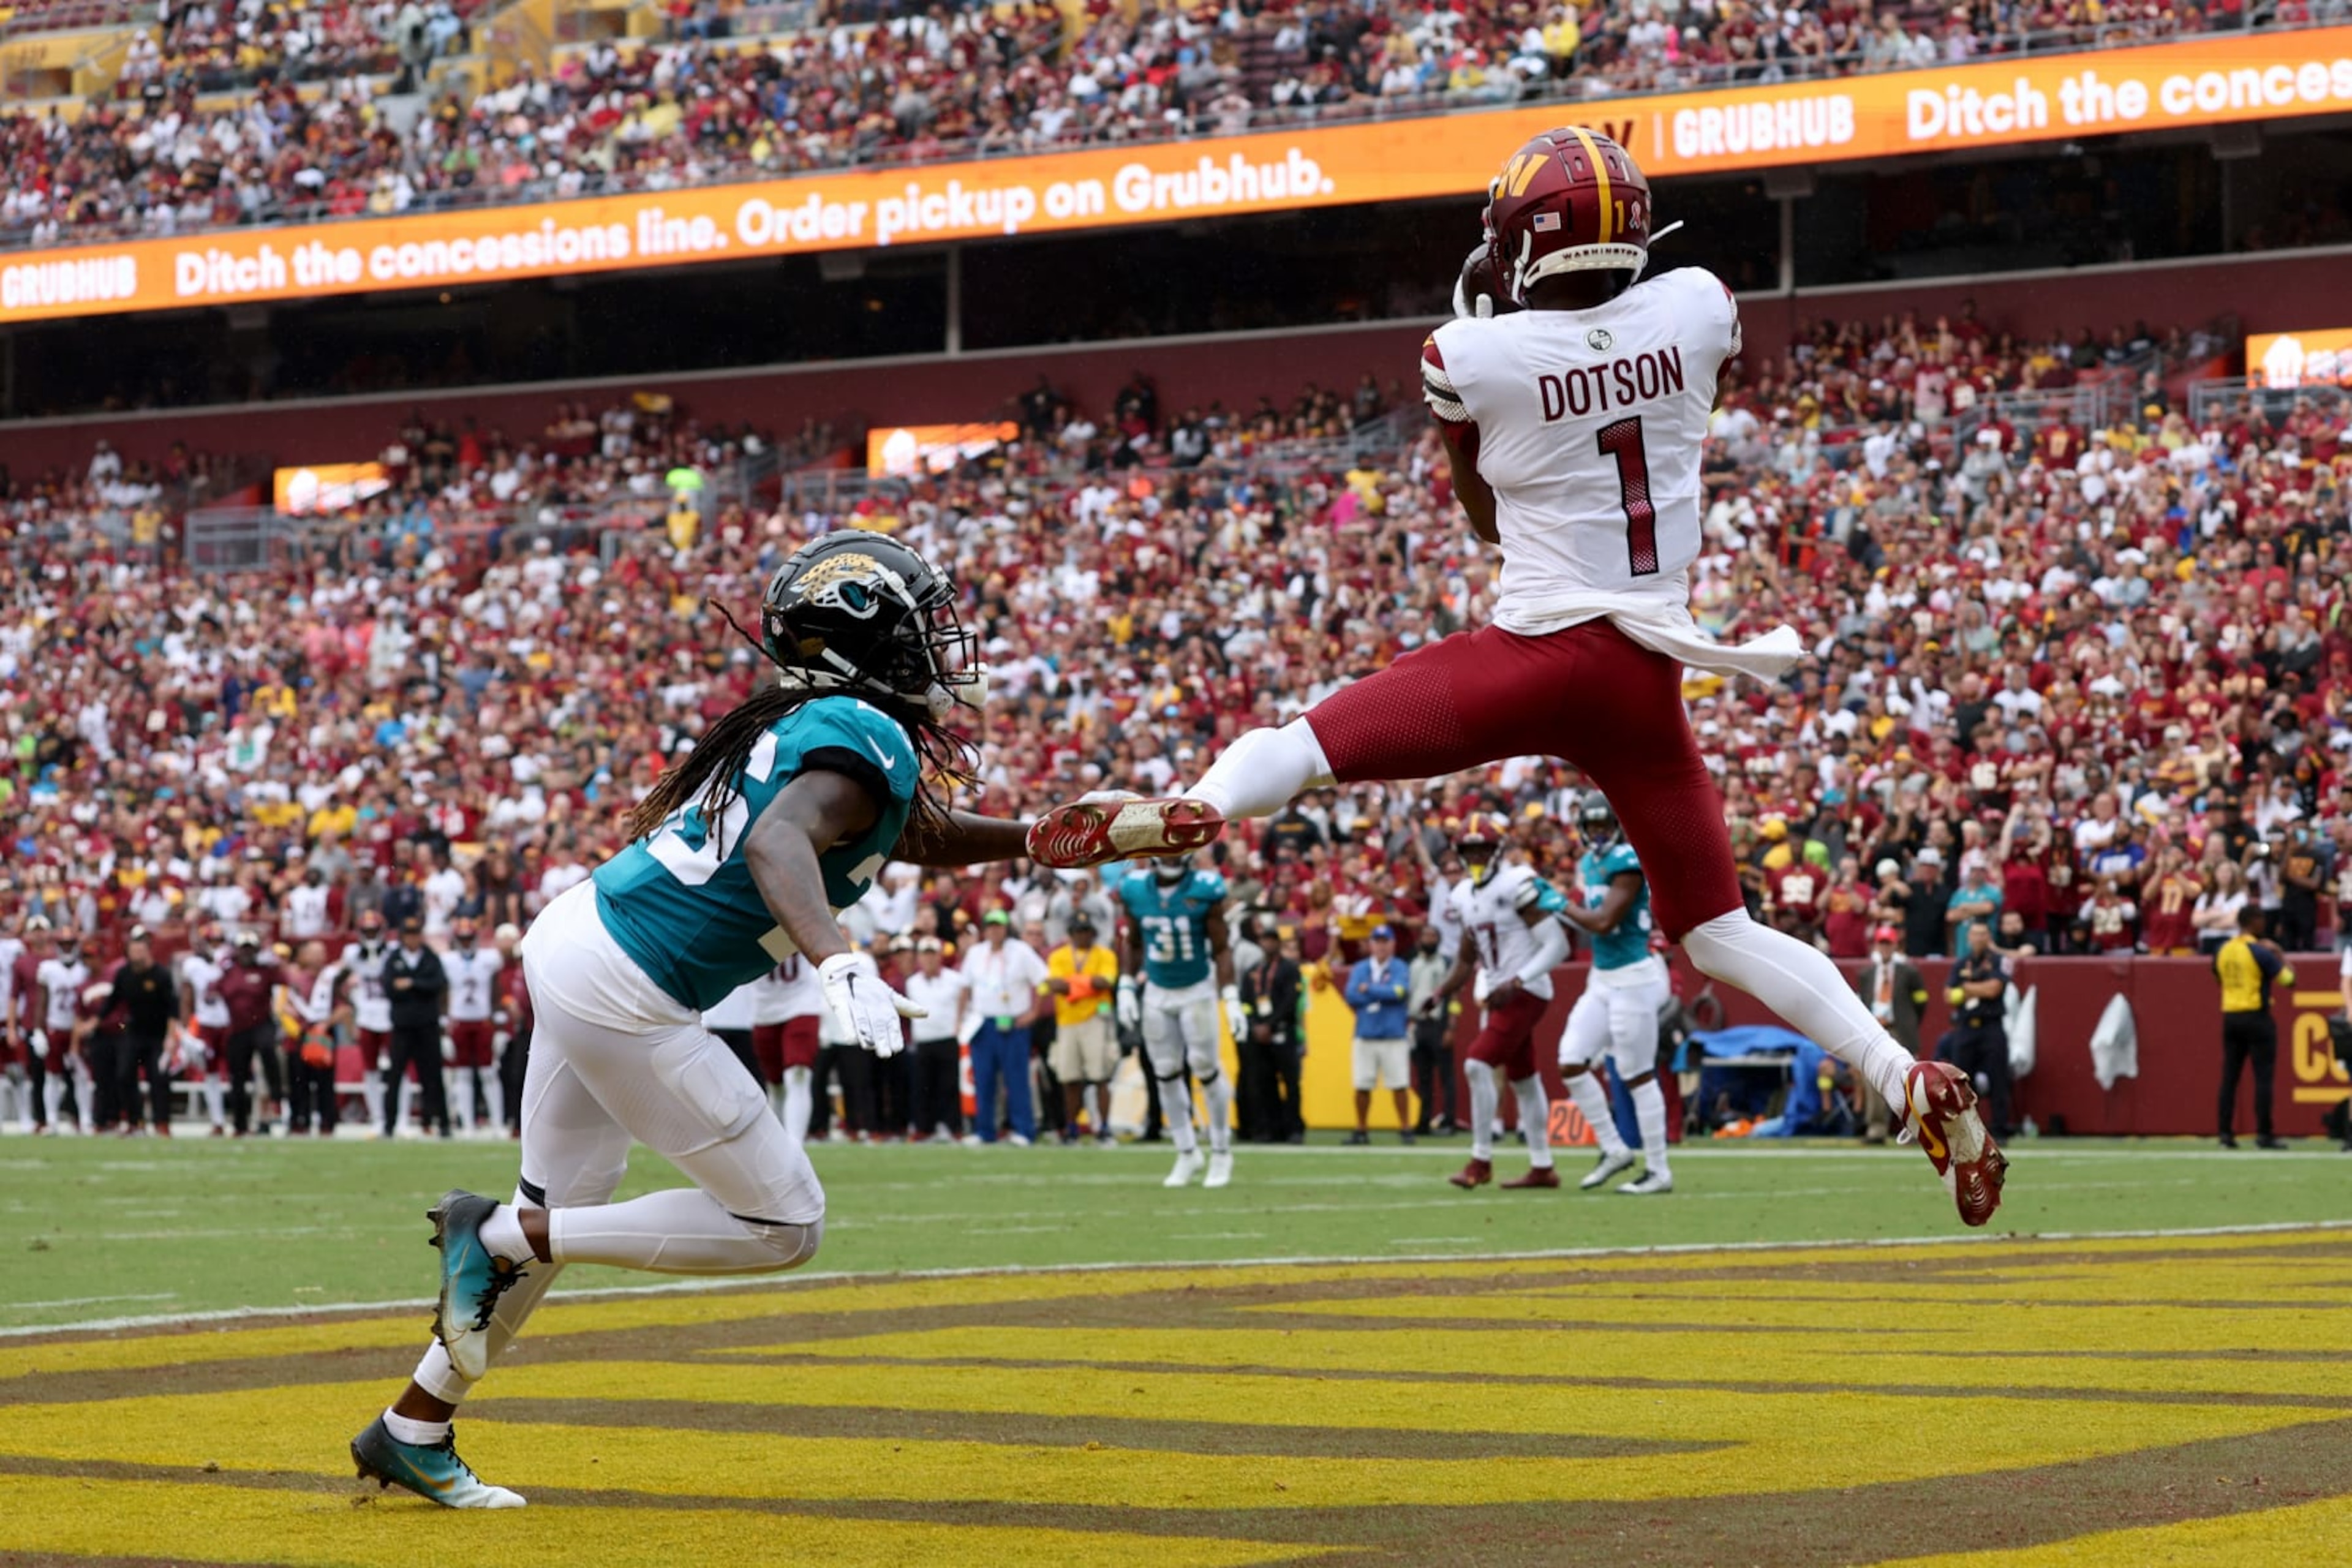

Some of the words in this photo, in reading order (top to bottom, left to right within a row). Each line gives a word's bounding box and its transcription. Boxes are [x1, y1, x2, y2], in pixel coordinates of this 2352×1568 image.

[1673, 94, 1855, 158] GRUBHUB
[1907, 78, 2048, 140] Ditch
[2057, 70, 2149, 125] the
[175, 244, 287, 296] Ditch
[292, 241, 363, 287] the
[369, 218, 631, 281] concessions
[637, 208, 728, 256] line.
[736, 193, 869, 246] Order
[876, 180, 1036, 246] pickup
[1044, 179, 1105, 219] on
[1113, 147, 1334, 213] Grubhub.
[1615, 200, 1624, 234] 1
[2, 255, 137, 308] GRUBHUB
[1539, 345, 1684, 422] DOTSON
[1596, 415, 1659, 576] 1
[1141, 916, 1194, 962] 31
[1551, 1105, 1585, 1141] 20
